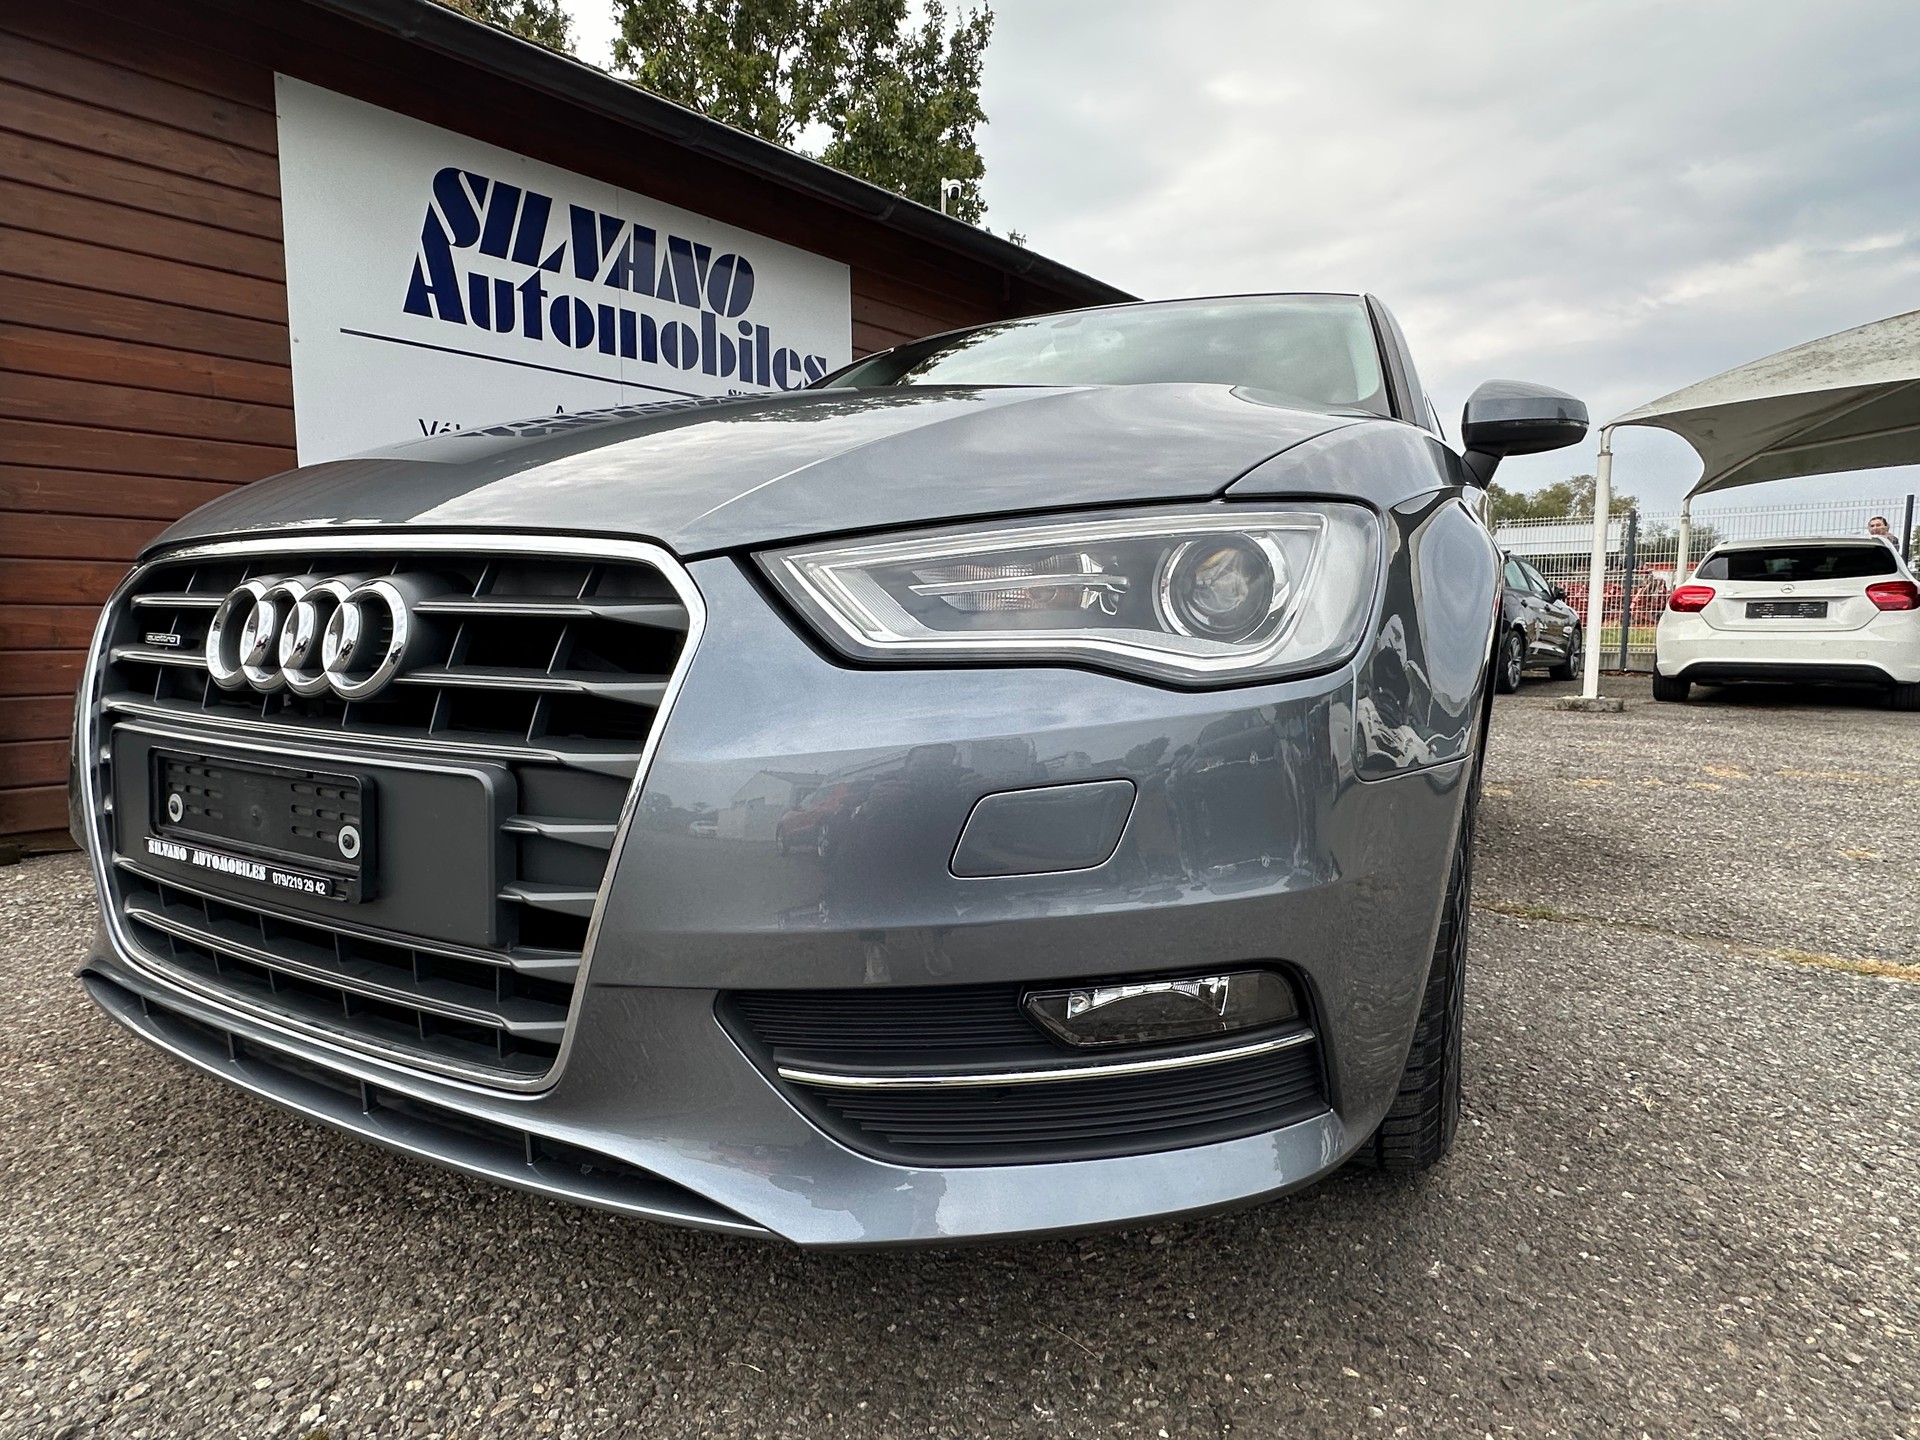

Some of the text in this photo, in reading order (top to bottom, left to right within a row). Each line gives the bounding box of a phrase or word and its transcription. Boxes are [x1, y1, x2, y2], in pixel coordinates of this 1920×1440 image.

[403, 202, 827, 391] Automobiles
[433, 167, 755, 318] SILVANO
[148, 839, 326, 895] SILVANO AUTOMOBILES 079/219 29 42
